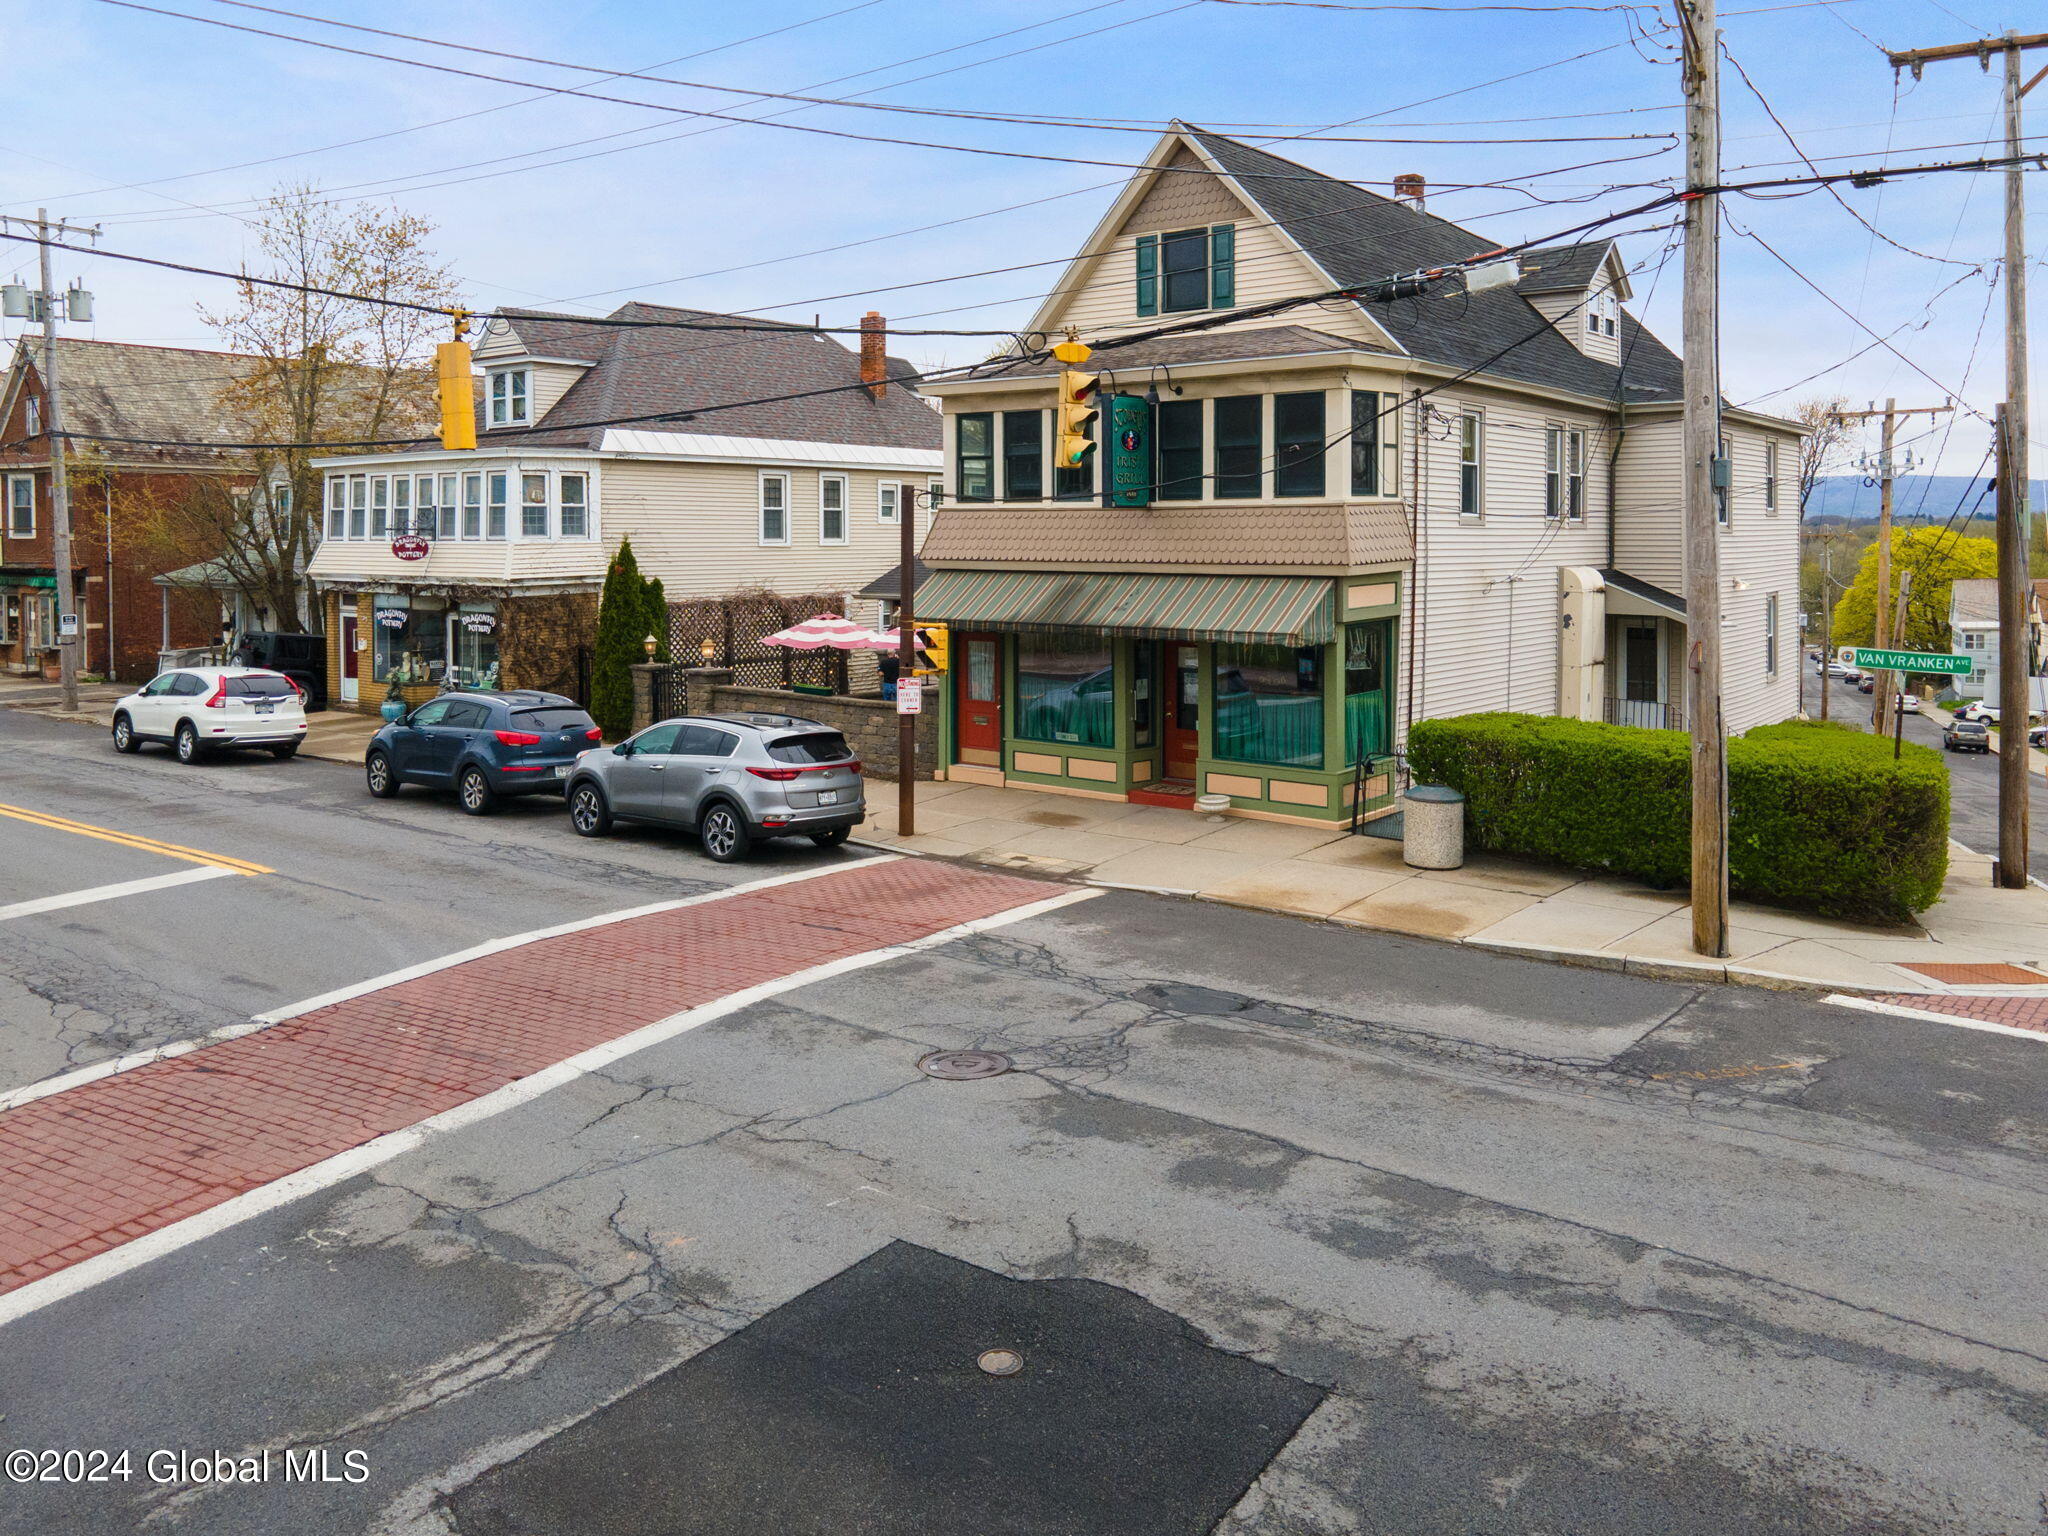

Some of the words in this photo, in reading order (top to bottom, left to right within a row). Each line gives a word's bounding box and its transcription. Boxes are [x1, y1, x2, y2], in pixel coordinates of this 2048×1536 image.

[376, 609, 408, 622] DRAGONFLY
[461, 613, 496, 627] DRAGONFLY
[1858, 653, 1884, 664] VAN
[1889, 655, 1954, 669] VRANKEN
